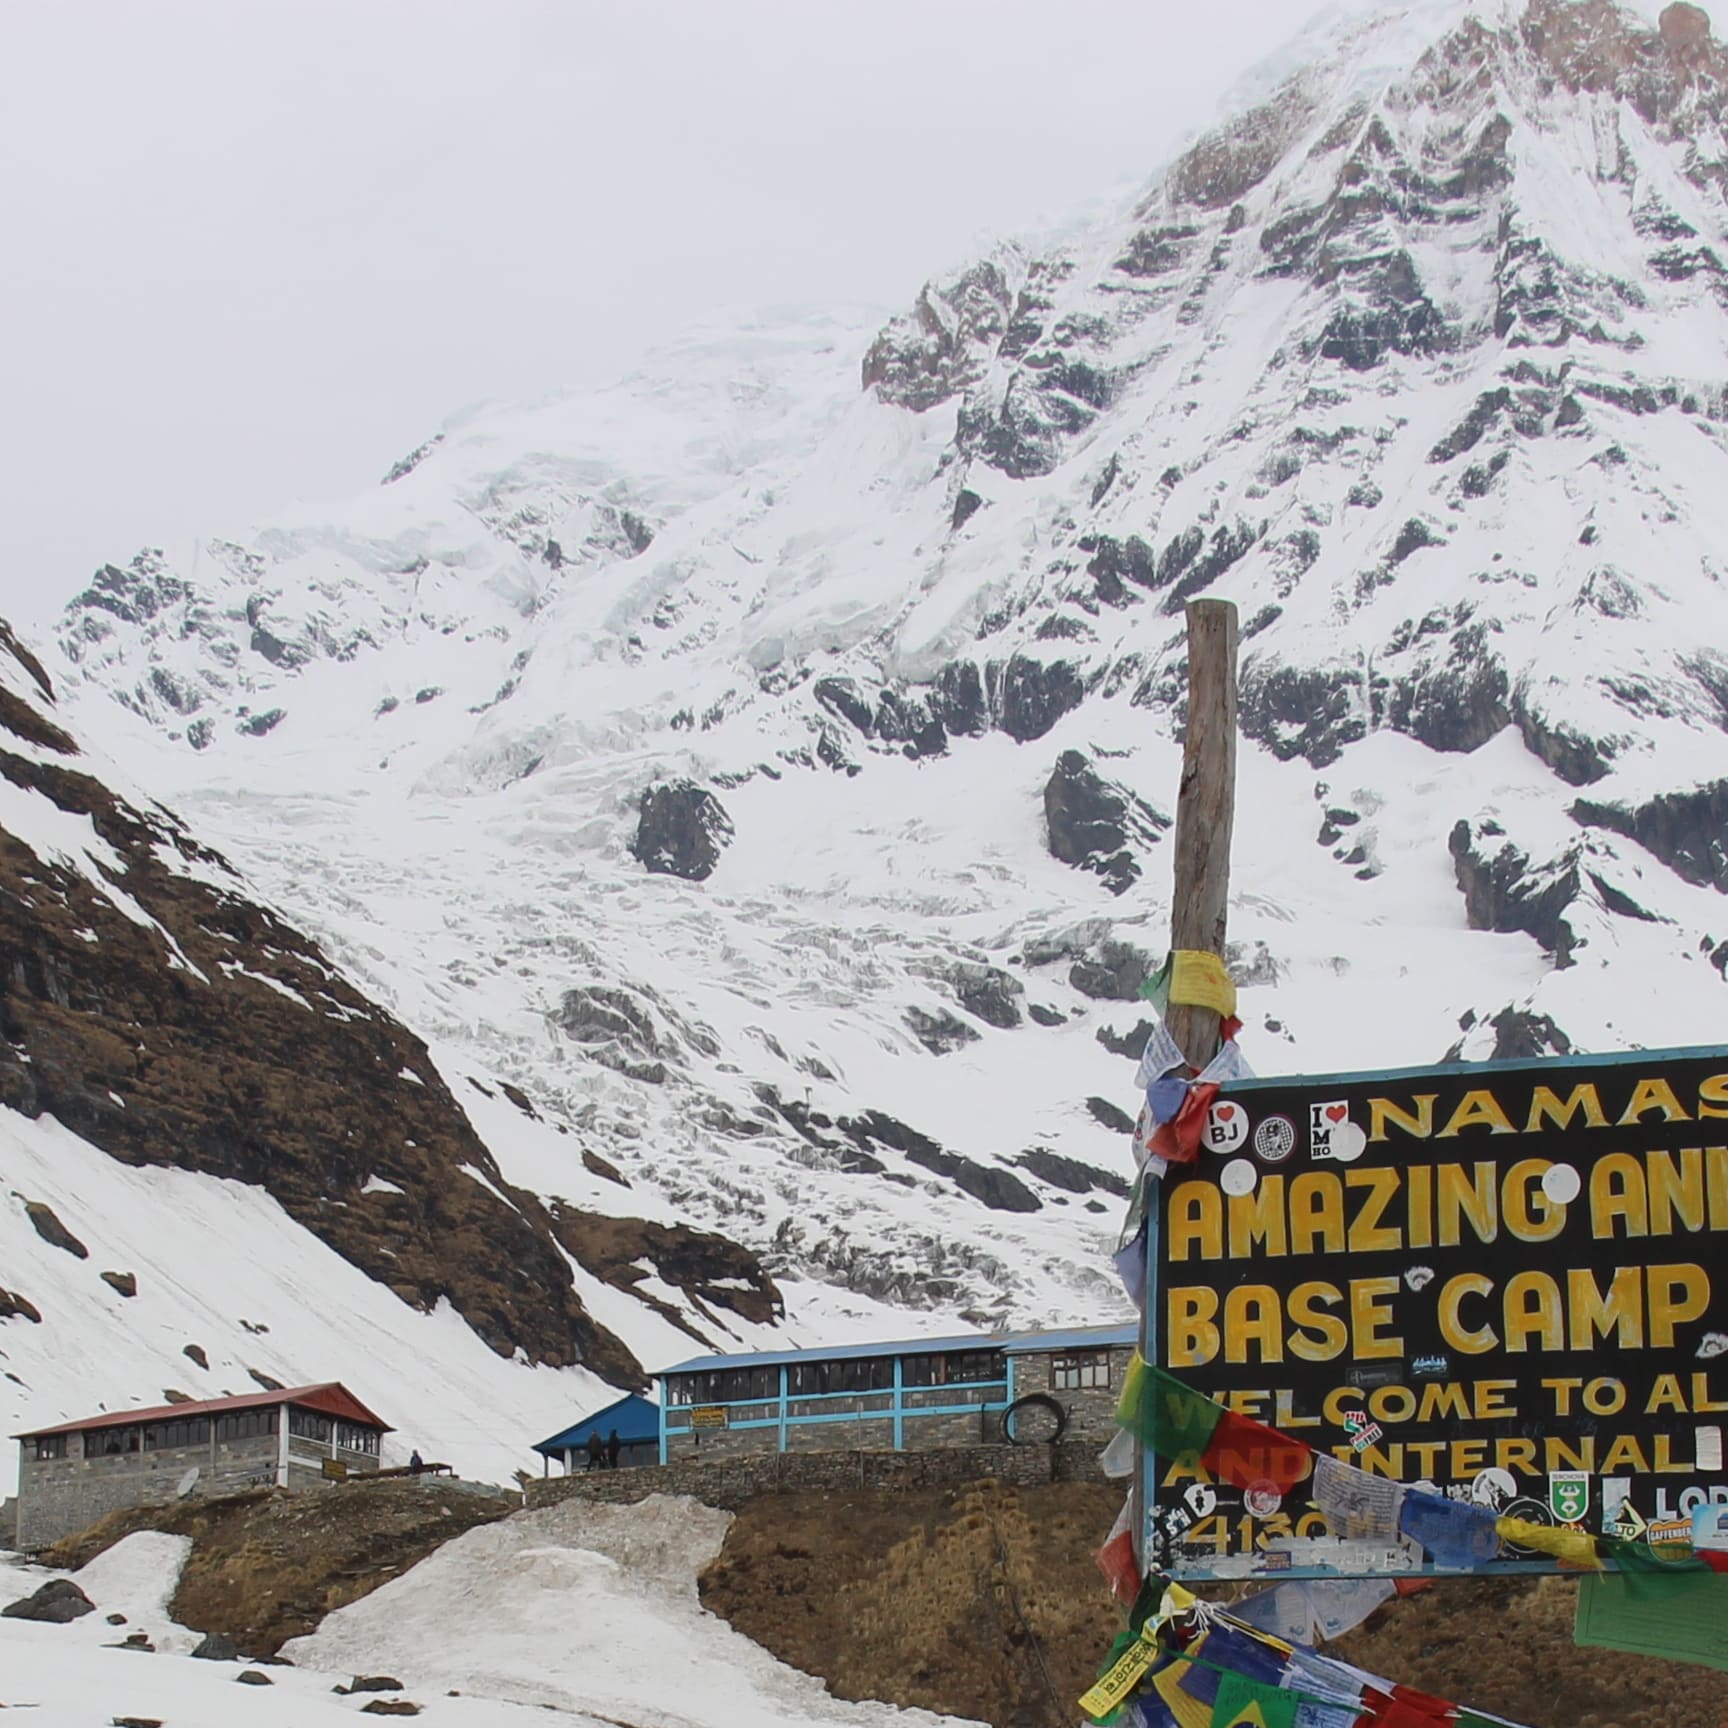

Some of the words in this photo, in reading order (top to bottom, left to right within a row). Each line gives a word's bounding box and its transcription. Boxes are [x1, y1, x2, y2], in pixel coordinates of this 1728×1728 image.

[1211, 1124, 1238, 1144] BJ
[1168, 1158, 1568, 1262] AMAZING
[1168, 1276, 1404, 1368] BASE
[1437, 1262, 1711, 1354] CAMP
[1541, 1376, 1627, 1416] TO
[1331, 1433, 1695, 1482] INTERNAL
